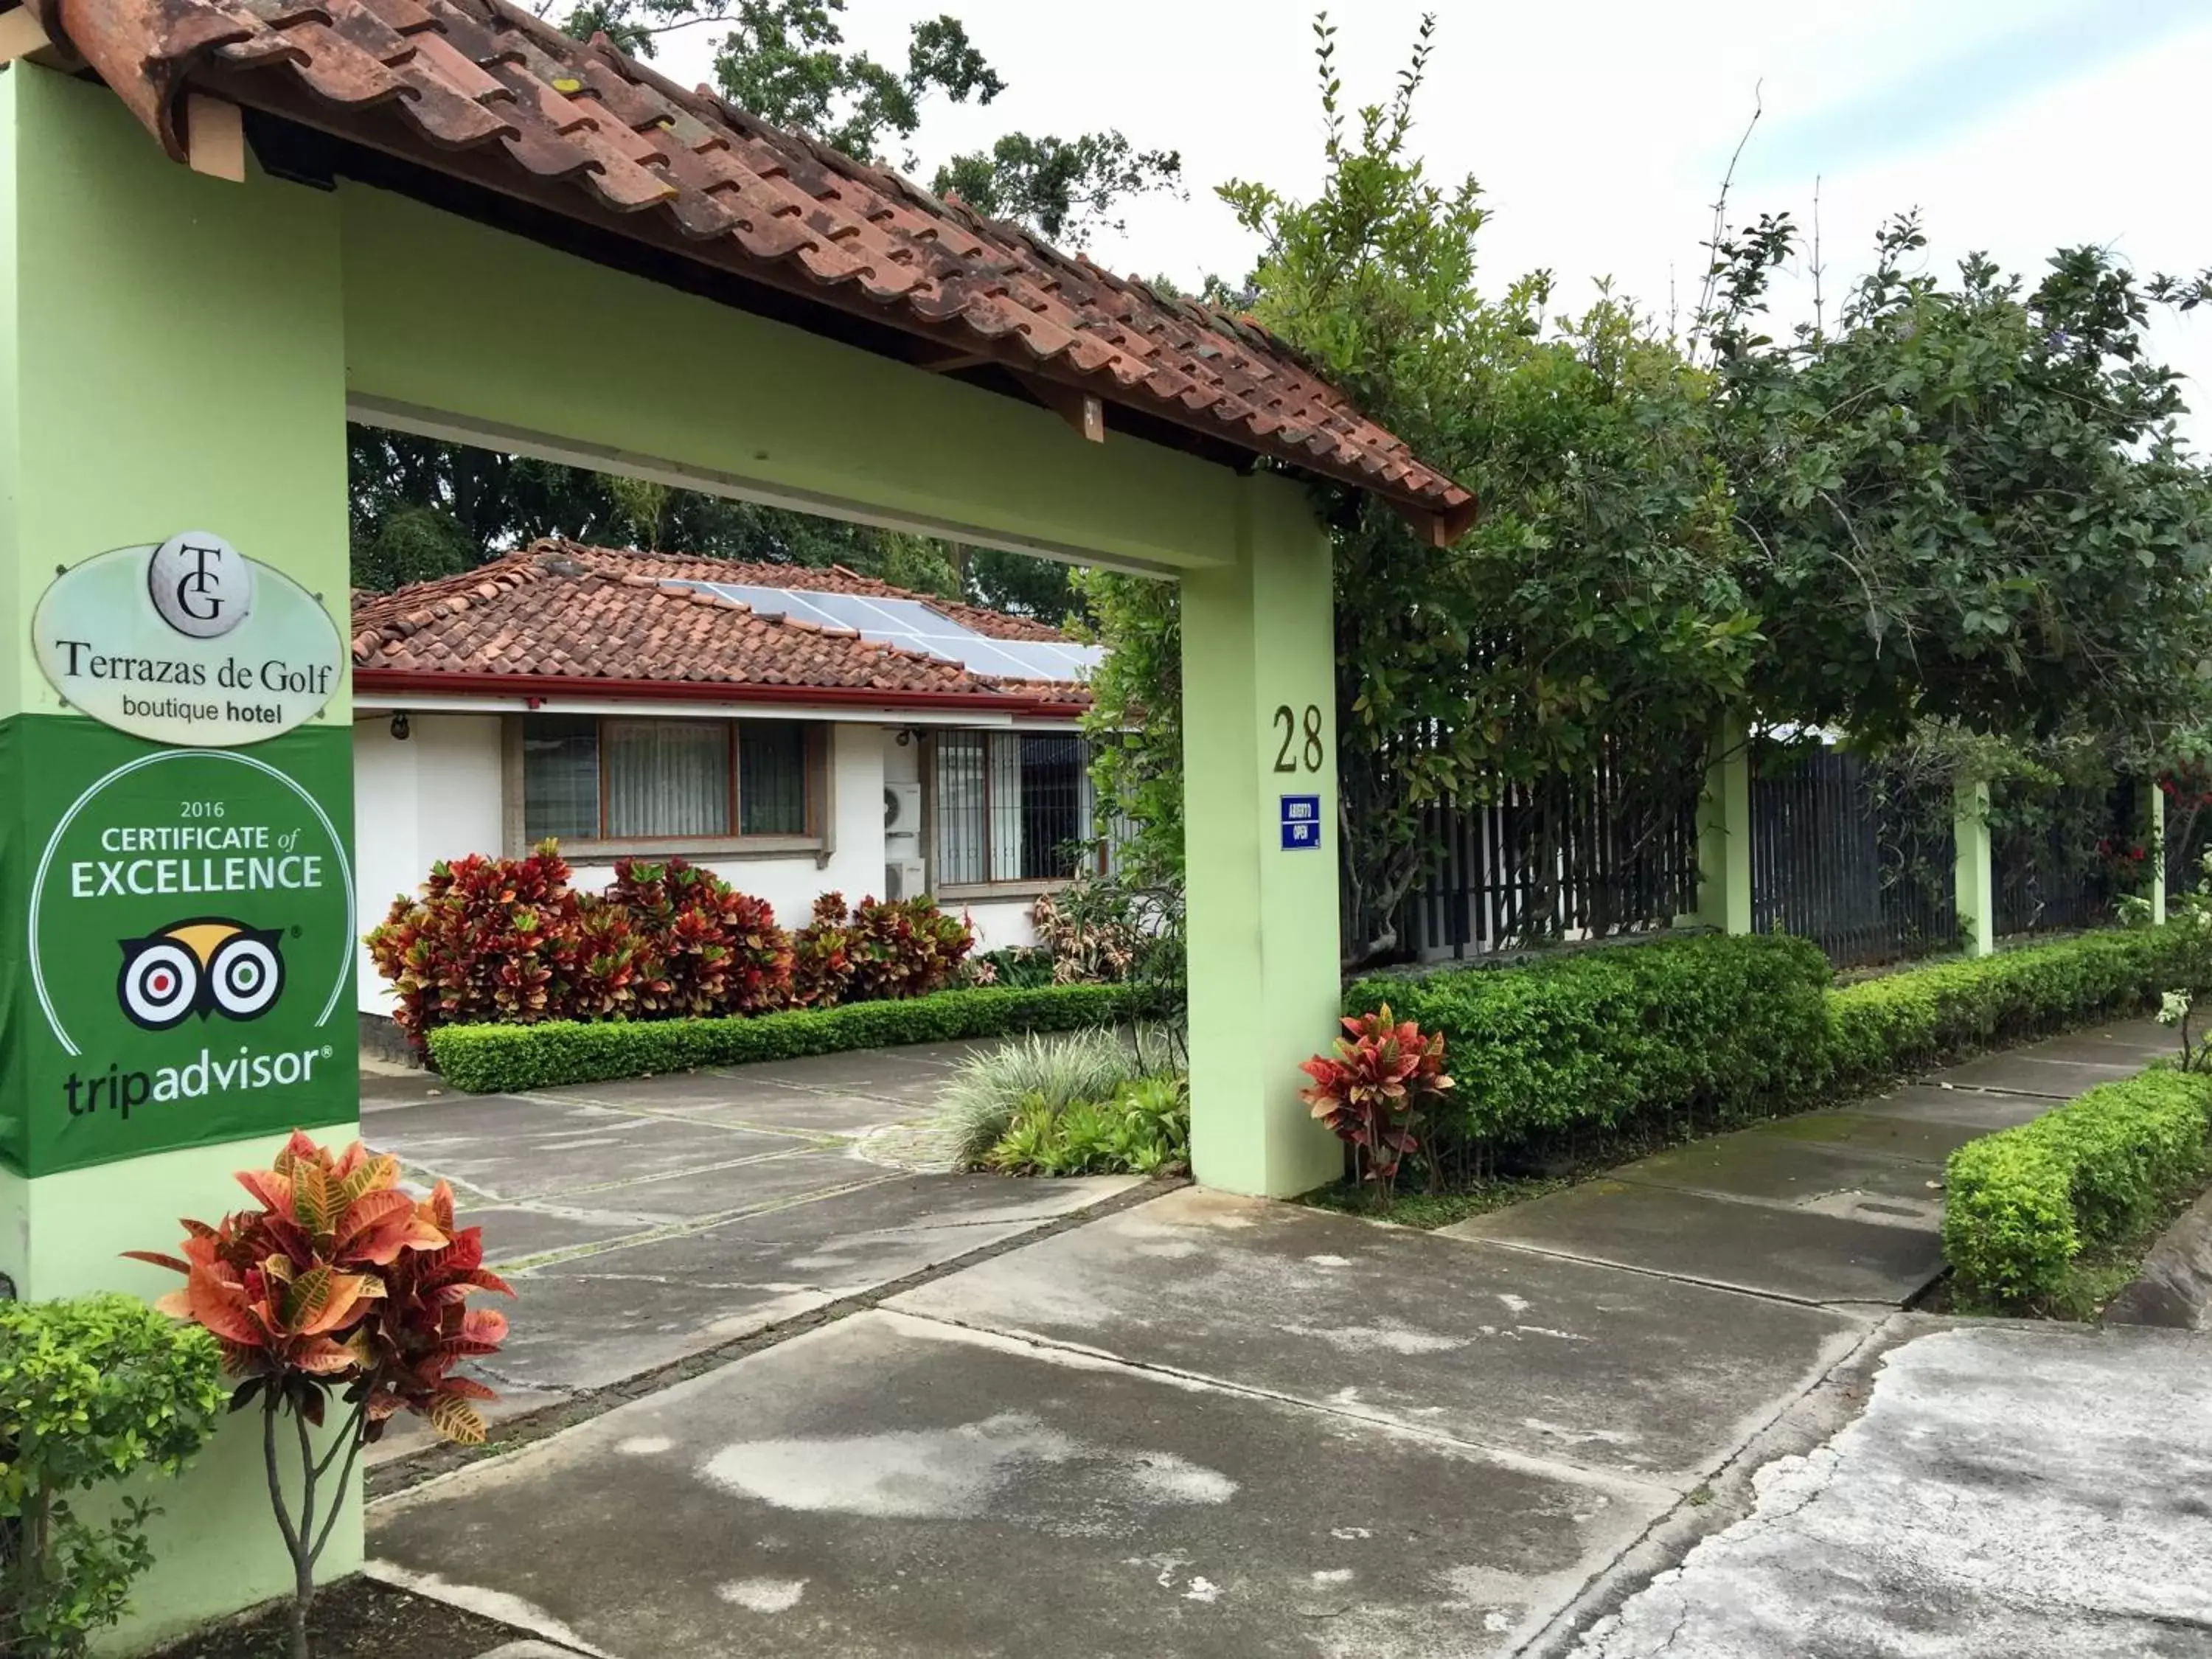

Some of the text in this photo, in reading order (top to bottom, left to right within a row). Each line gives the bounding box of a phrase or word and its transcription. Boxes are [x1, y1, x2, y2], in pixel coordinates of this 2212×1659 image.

[56, 640, 333, 695] Terrazas de Golf
[123, 695, 282, 723] boutique hotel
[1273, 704, 1323, 773] 28
[180, 801, 225, 818] 2016
[101, 827, 299, 852] CERTIFICATE of
[1293, 825, 1308, 840] OPEN
[72, 856, 322, 897] EXCELLENCE
